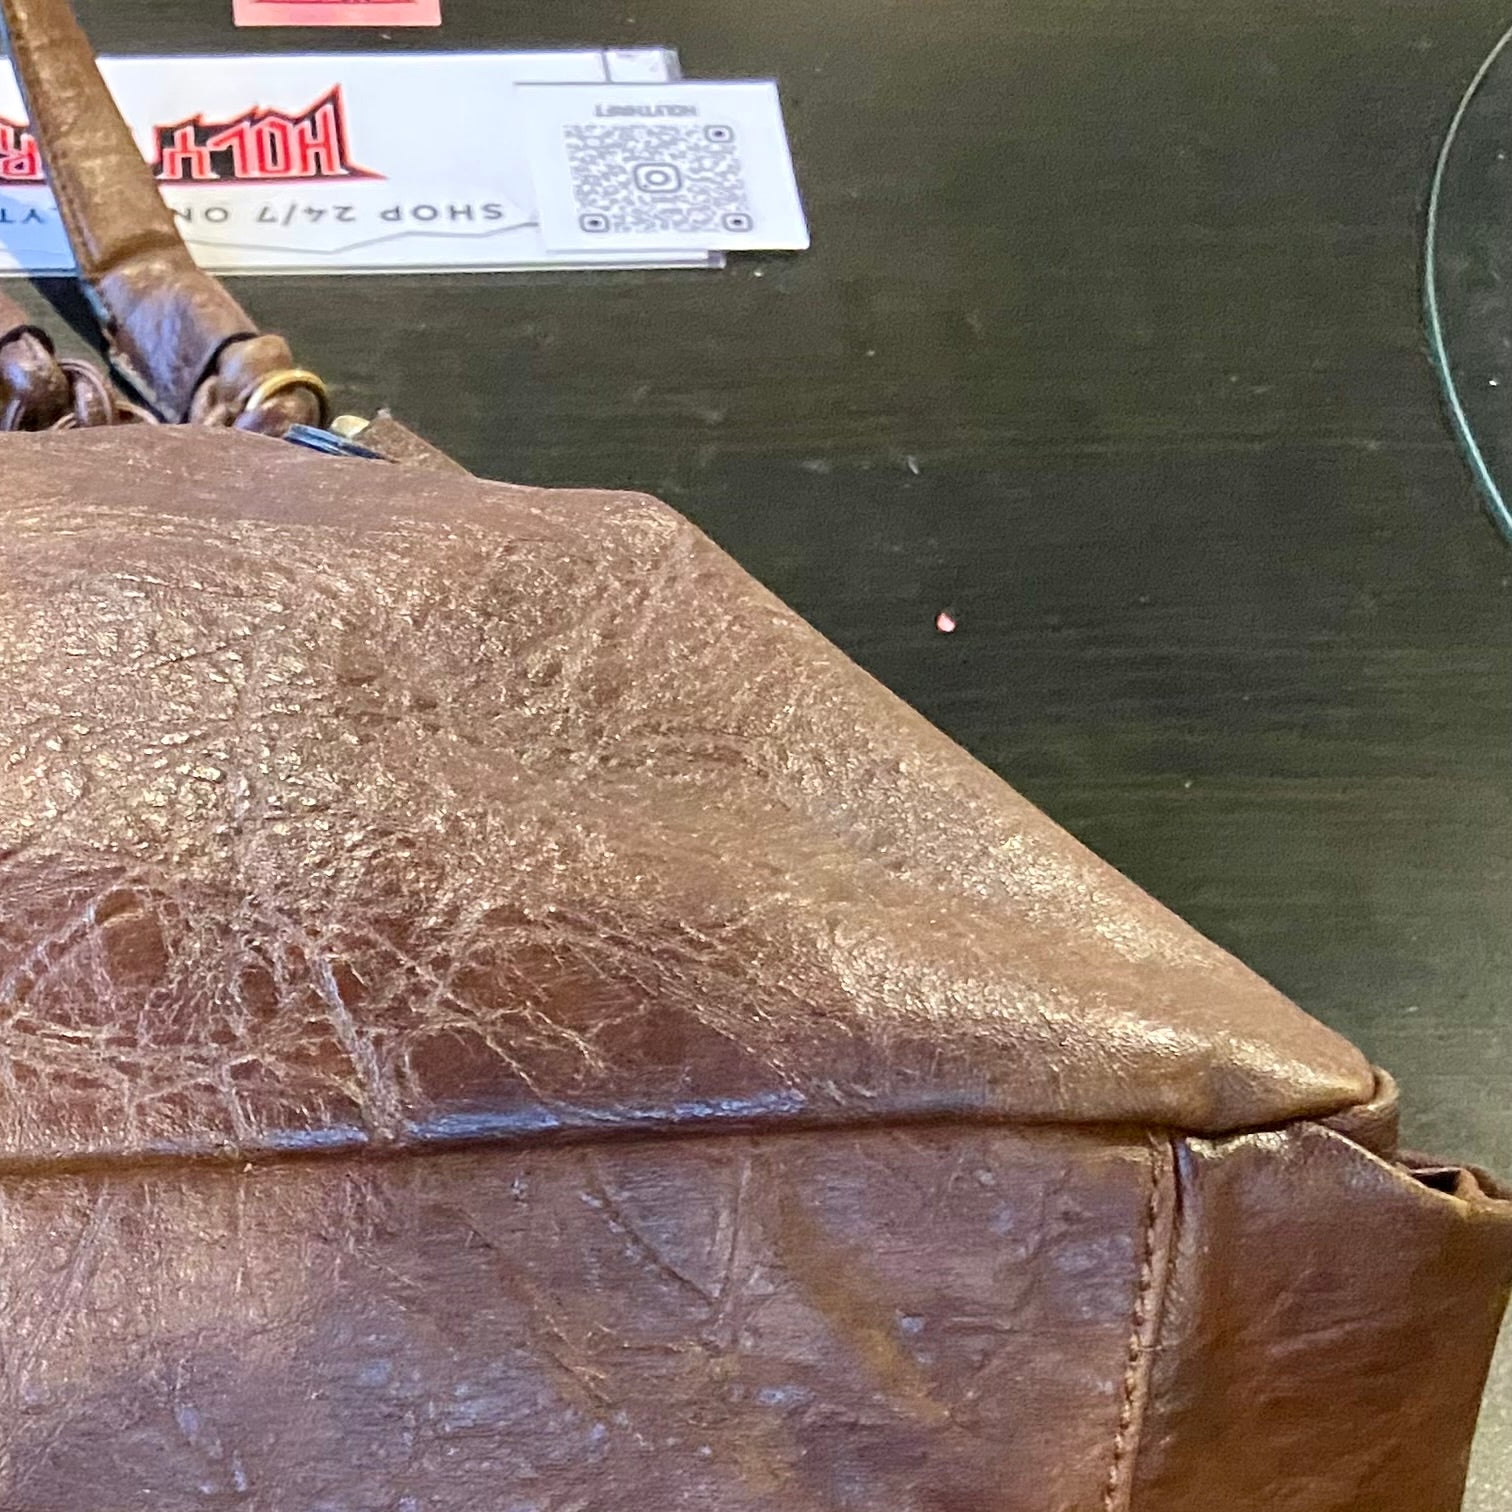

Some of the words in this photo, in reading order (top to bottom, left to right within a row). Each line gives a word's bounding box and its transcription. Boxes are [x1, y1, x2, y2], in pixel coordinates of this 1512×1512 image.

[155, 103, 348, 180] HOLY
[256, 203, 355, 224] 24/7
[379, 203, 504, 222] SHOP
